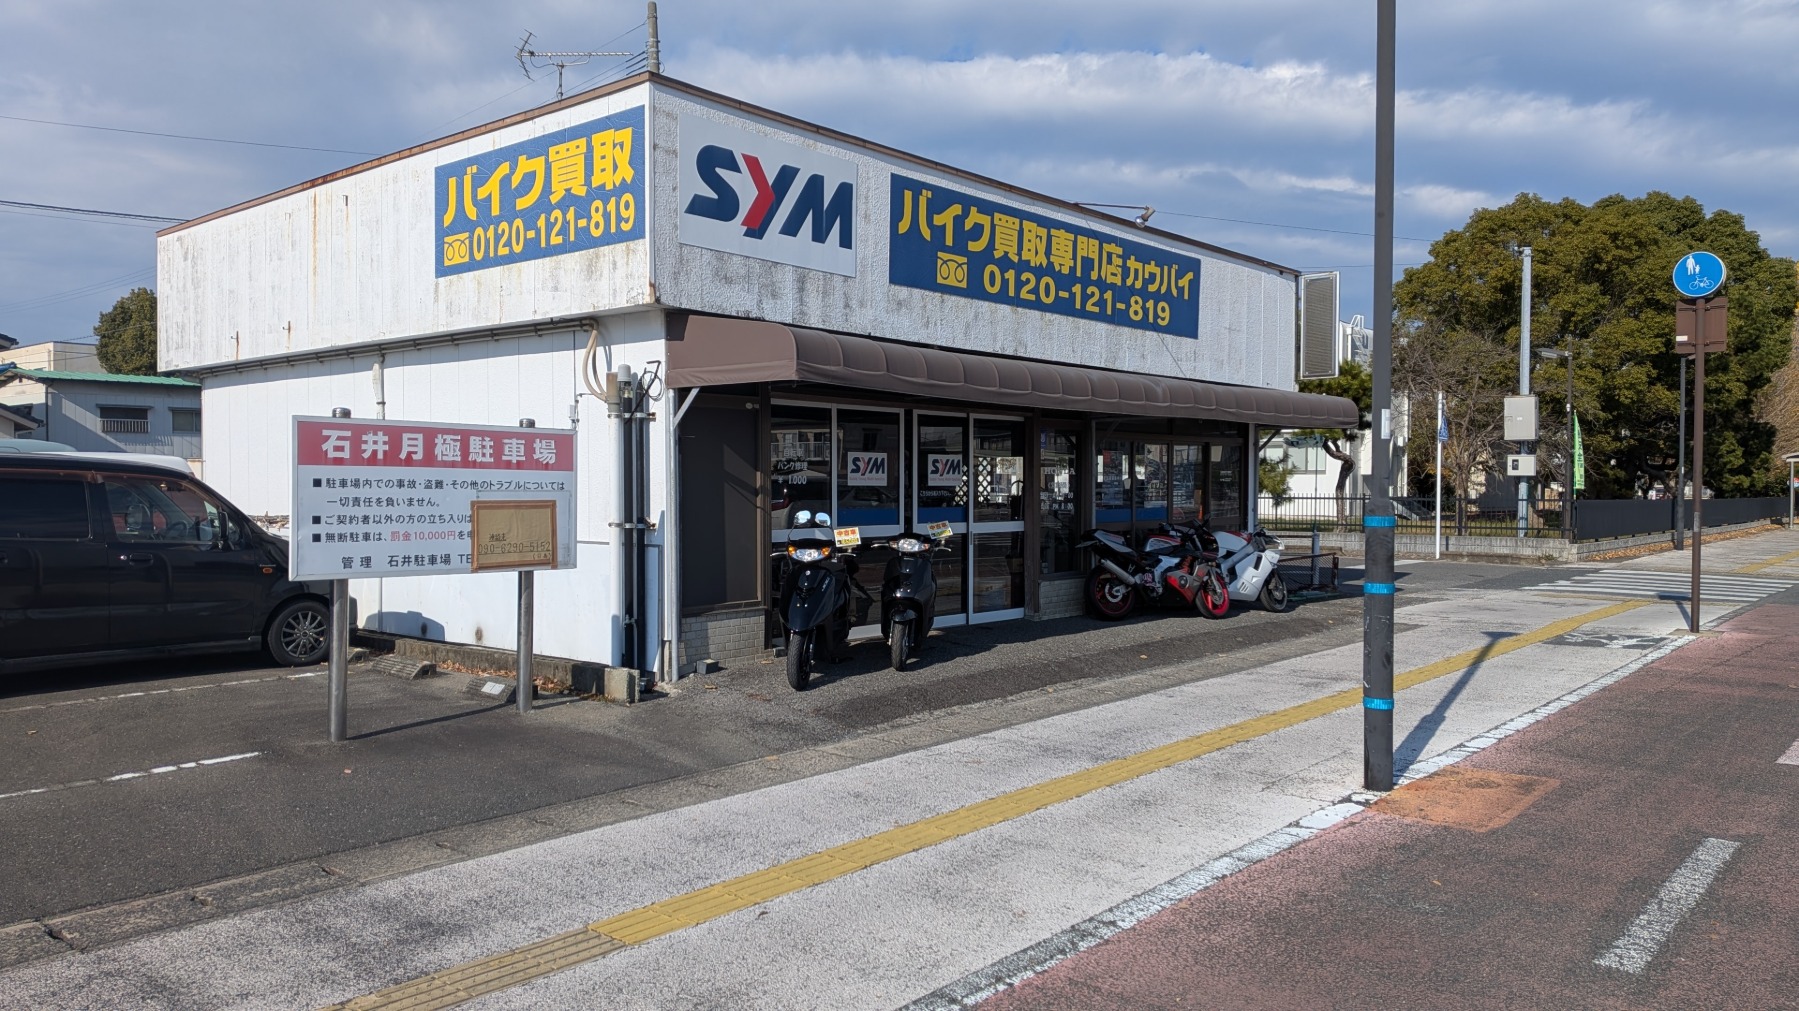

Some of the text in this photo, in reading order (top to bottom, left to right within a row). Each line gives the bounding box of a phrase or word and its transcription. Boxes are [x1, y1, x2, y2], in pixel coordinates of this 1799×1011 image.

[443, 126, 636, 229] バイク買取
[684, 144, 854, 251] SYM
[472, 196, 636, 262] 0120-121-819
[983, 264, 1171, 327] 0120-121-819
[320, 428, 557, 465] 石井月極駐車場
[850, 456, 886, 476] SYM
[930, 458, 962, 477] SYM
[325, 477, 566, 491] 駐車場内での事故・盗難・その他のトラブルについては
[326, 496, 440, 508] 一切責任を負いません。
[386, 553, 452, 568] 石井駐車場
